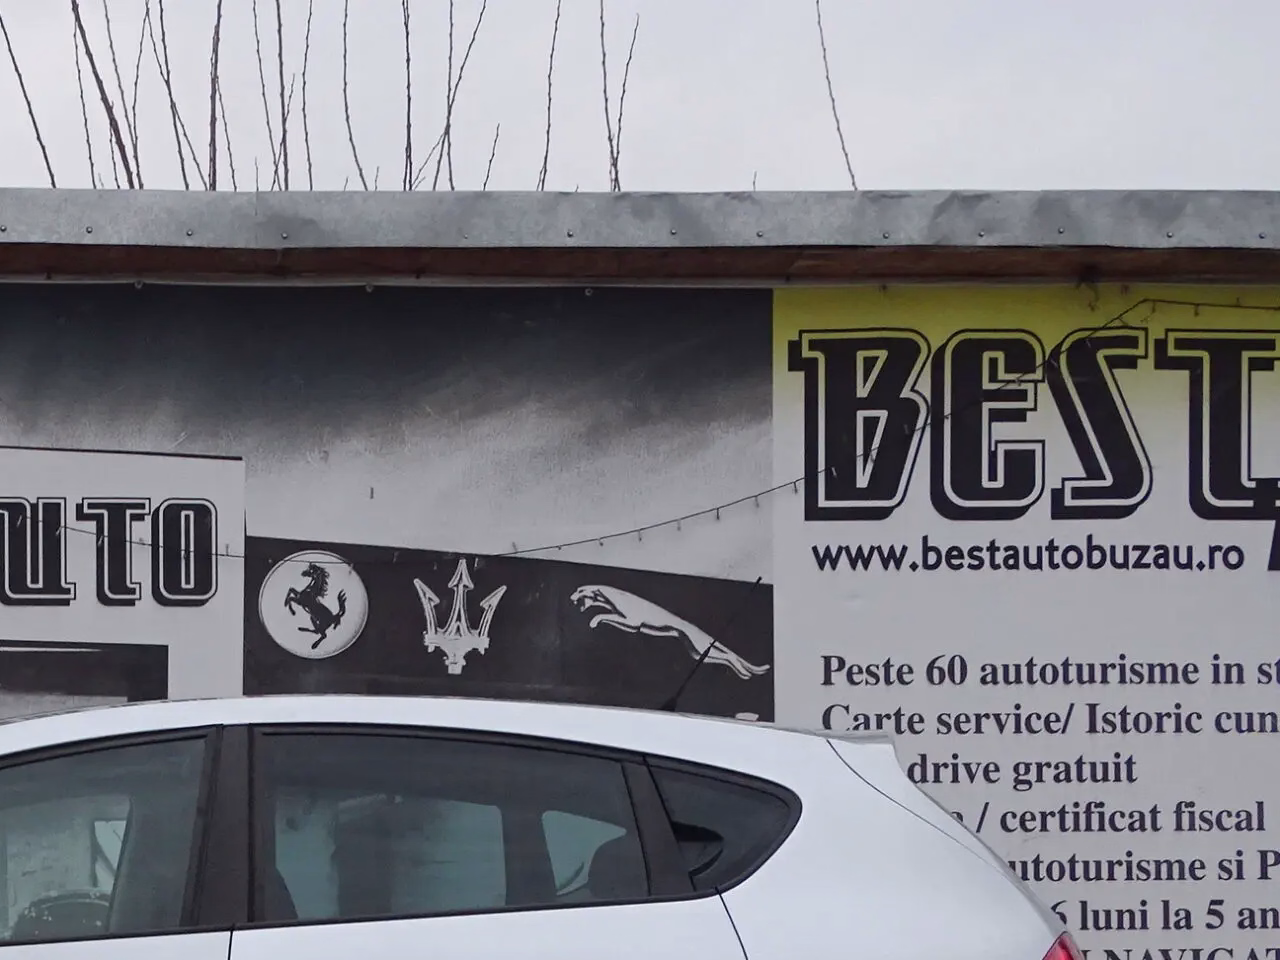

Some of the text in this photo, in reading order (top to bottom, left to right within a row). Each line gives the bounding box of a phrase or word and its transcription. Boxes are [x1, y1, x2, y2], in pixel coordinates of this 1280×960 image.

[788, 328, 1280, 522] BEST
[812, 534, 1245, 572] www.bestautobuzau.ro
[821, 655, 914, 686] Peste
[926, 655, 968, 686] 60
[979, 654, 1200, 686] autoturisme
[1212, 654, 1245, 685] in
[822, 703, 925, 735] Carte
[936, 703, 1075, 735] service/
[1086, 702, 1203, 734] Istoric
[907, 752, 1138, 792] drive gratuit
[999, 801, 1162, 833] certificat
[1173, 800, 1266, 832] fiscal
[1217, 849, 1245, 881] si
[1079, 898, 1150, 931] luni
[1161, 899, 1194, 931] la
[1205, 899, 1225, 930] 5
